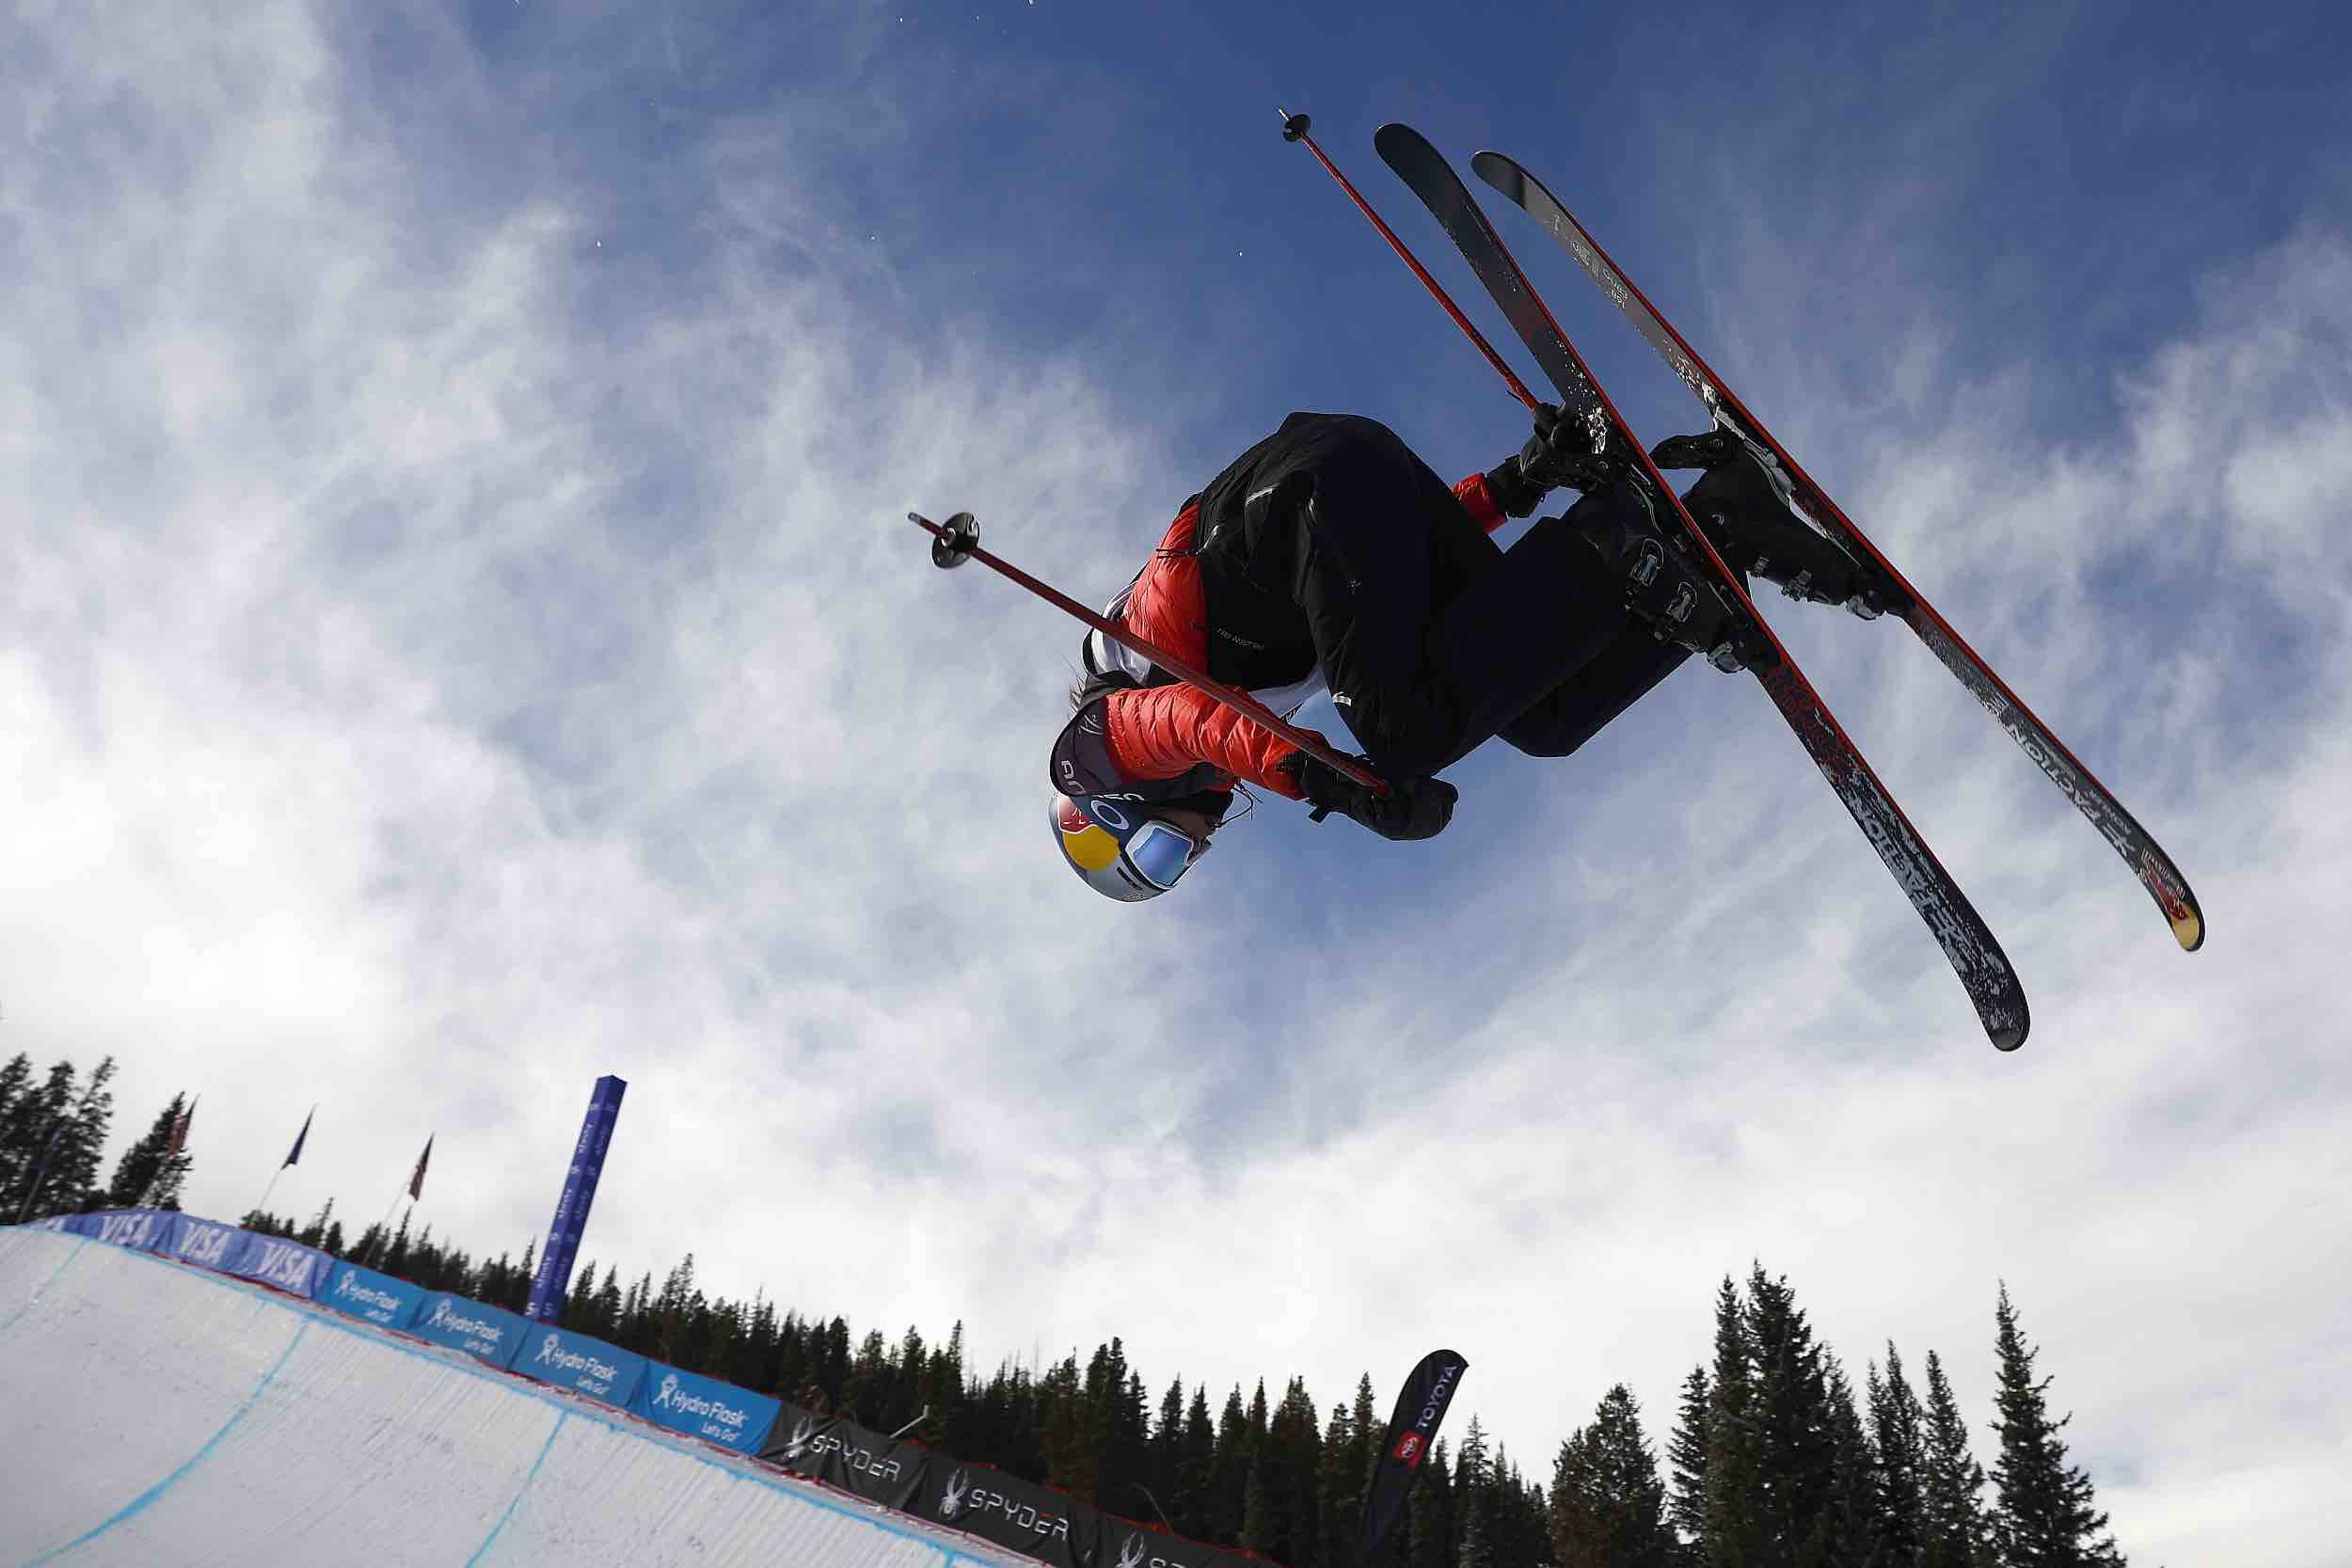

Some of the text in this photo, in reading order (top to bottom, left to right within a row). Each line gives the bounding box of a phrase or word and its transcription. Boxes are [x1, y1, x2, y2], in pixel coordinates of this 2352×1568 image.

[98, 1215, 153, 1243] VISA
[181, 1224, 231, 1265] VISA
[258, 1242, 316, 1289] VISA
[551, 1347, 617, 1382] Hydro Flask
[671, 1390, 749, 1428] Hydro Flask
[1415, 1366, 1457, 1428] TOYOTA
[810, 1434, 901, 1481] SPYDER
[968, 1489, 1070, 1541] SPYDER
